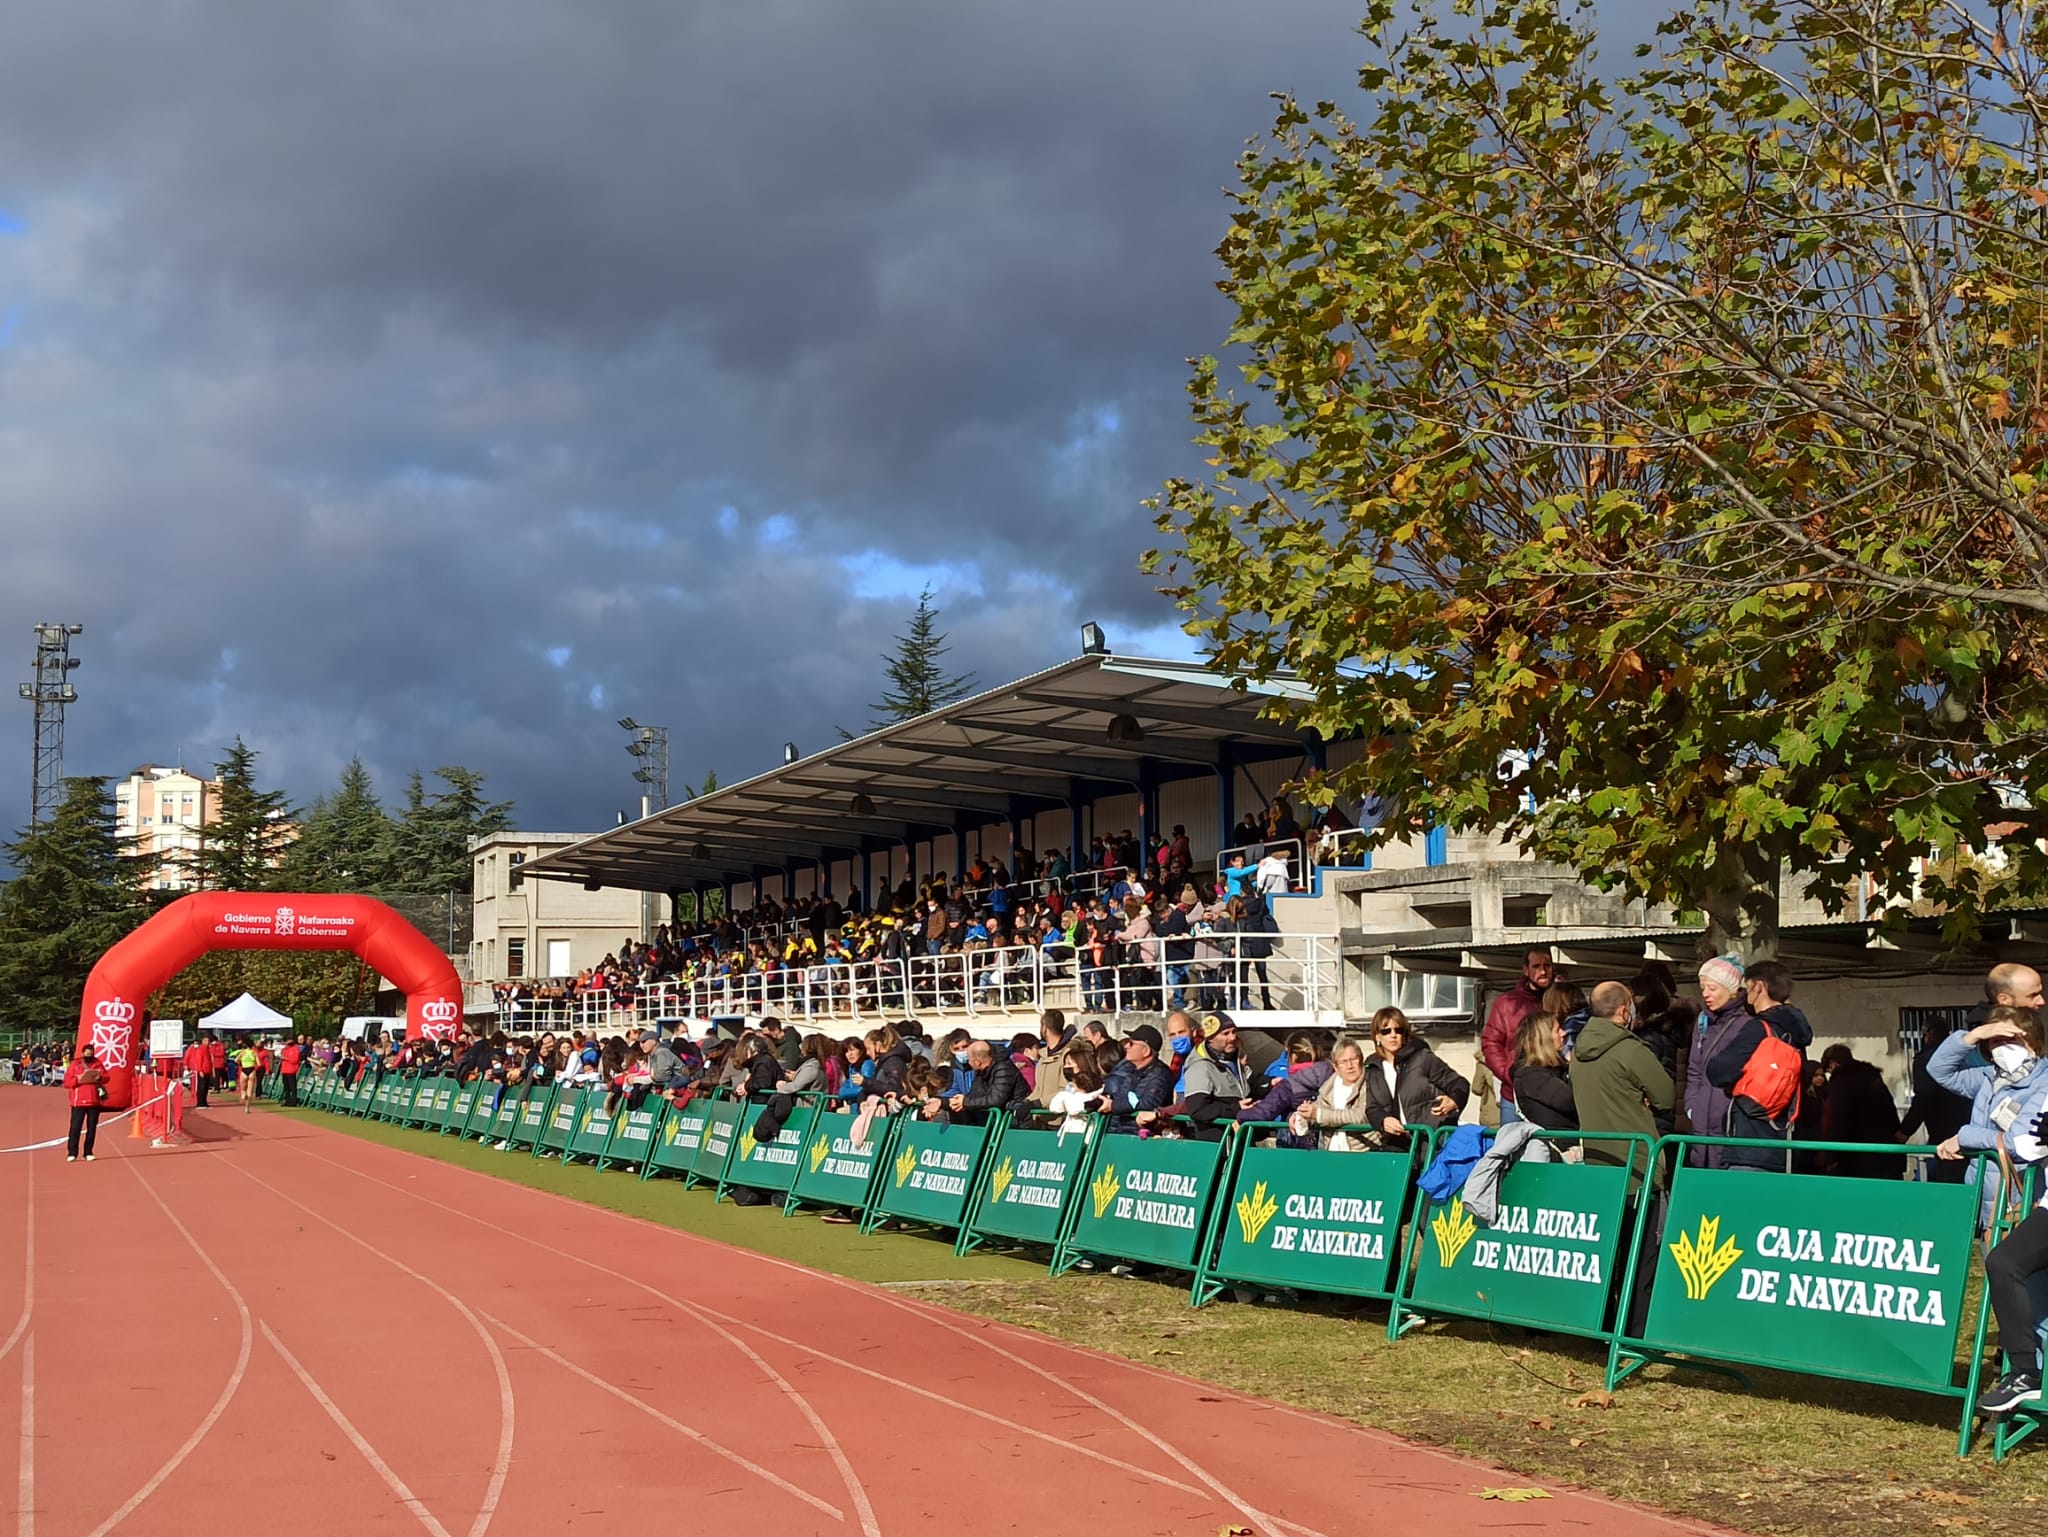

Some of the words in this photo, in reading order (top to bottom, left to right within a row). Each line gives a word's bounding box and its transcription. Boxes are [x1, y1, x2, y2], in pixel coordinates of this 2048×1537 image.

[214, 924, 228, 934] de
[230, 925, 271, 934] Navarra
[224, 913, 272, 924] Gobierno
[298, 915, 355, 925] Nafarroako
[298, 926, 347, 936] Gobernua
[822, 1157, 837, 1173] DE
[835, 1159, 870, 1178] NAVARRA
[921, 1149, 943, 1168] CAJA
[943, 1152, 970, 1171] RURAL
[1016, 1160, 1038, 1178] CAJA
[1037, 1162, 1066, 1181] RURAL
[910, 1171, 924, 1188] DE
[925, 1173, 966, 1195] NAVARRA
[1125, 1169, 1154, 1192] CAJA
[1154, 1173, 1197, 1197] RURAL
[1005, 1184, 1020, 1203] DE
[1020, 1186, 1062, 1208] NAVARRA
[1114, 1196, 1133, 1218] DE
[1133, 1200, 1195, 1228] NAVARRA
[1284, 1194, 1324, 1220] CAJA
[1327, 1197, 1384, 1224] RURAL
[1489, 1204, 1530, 1234] AJA
[1533, 1208, 1601, 1242] RURAL
[1271, 1225, 1298, 1251] DE
[1300, 1228, 1384, 1260] NAVARRA
[1756, 1225, 1825, 1262] CAJA
[1830, 1232, 1941, 1275] RURAL
[1472, 1240, 1502, 1269] DE
[1504, 1244, 1602, 1284] NAVARRA
[1736, 1268, 1780, 1304] DE
[1786, 1274, 1946, 1327] NAVARRA
